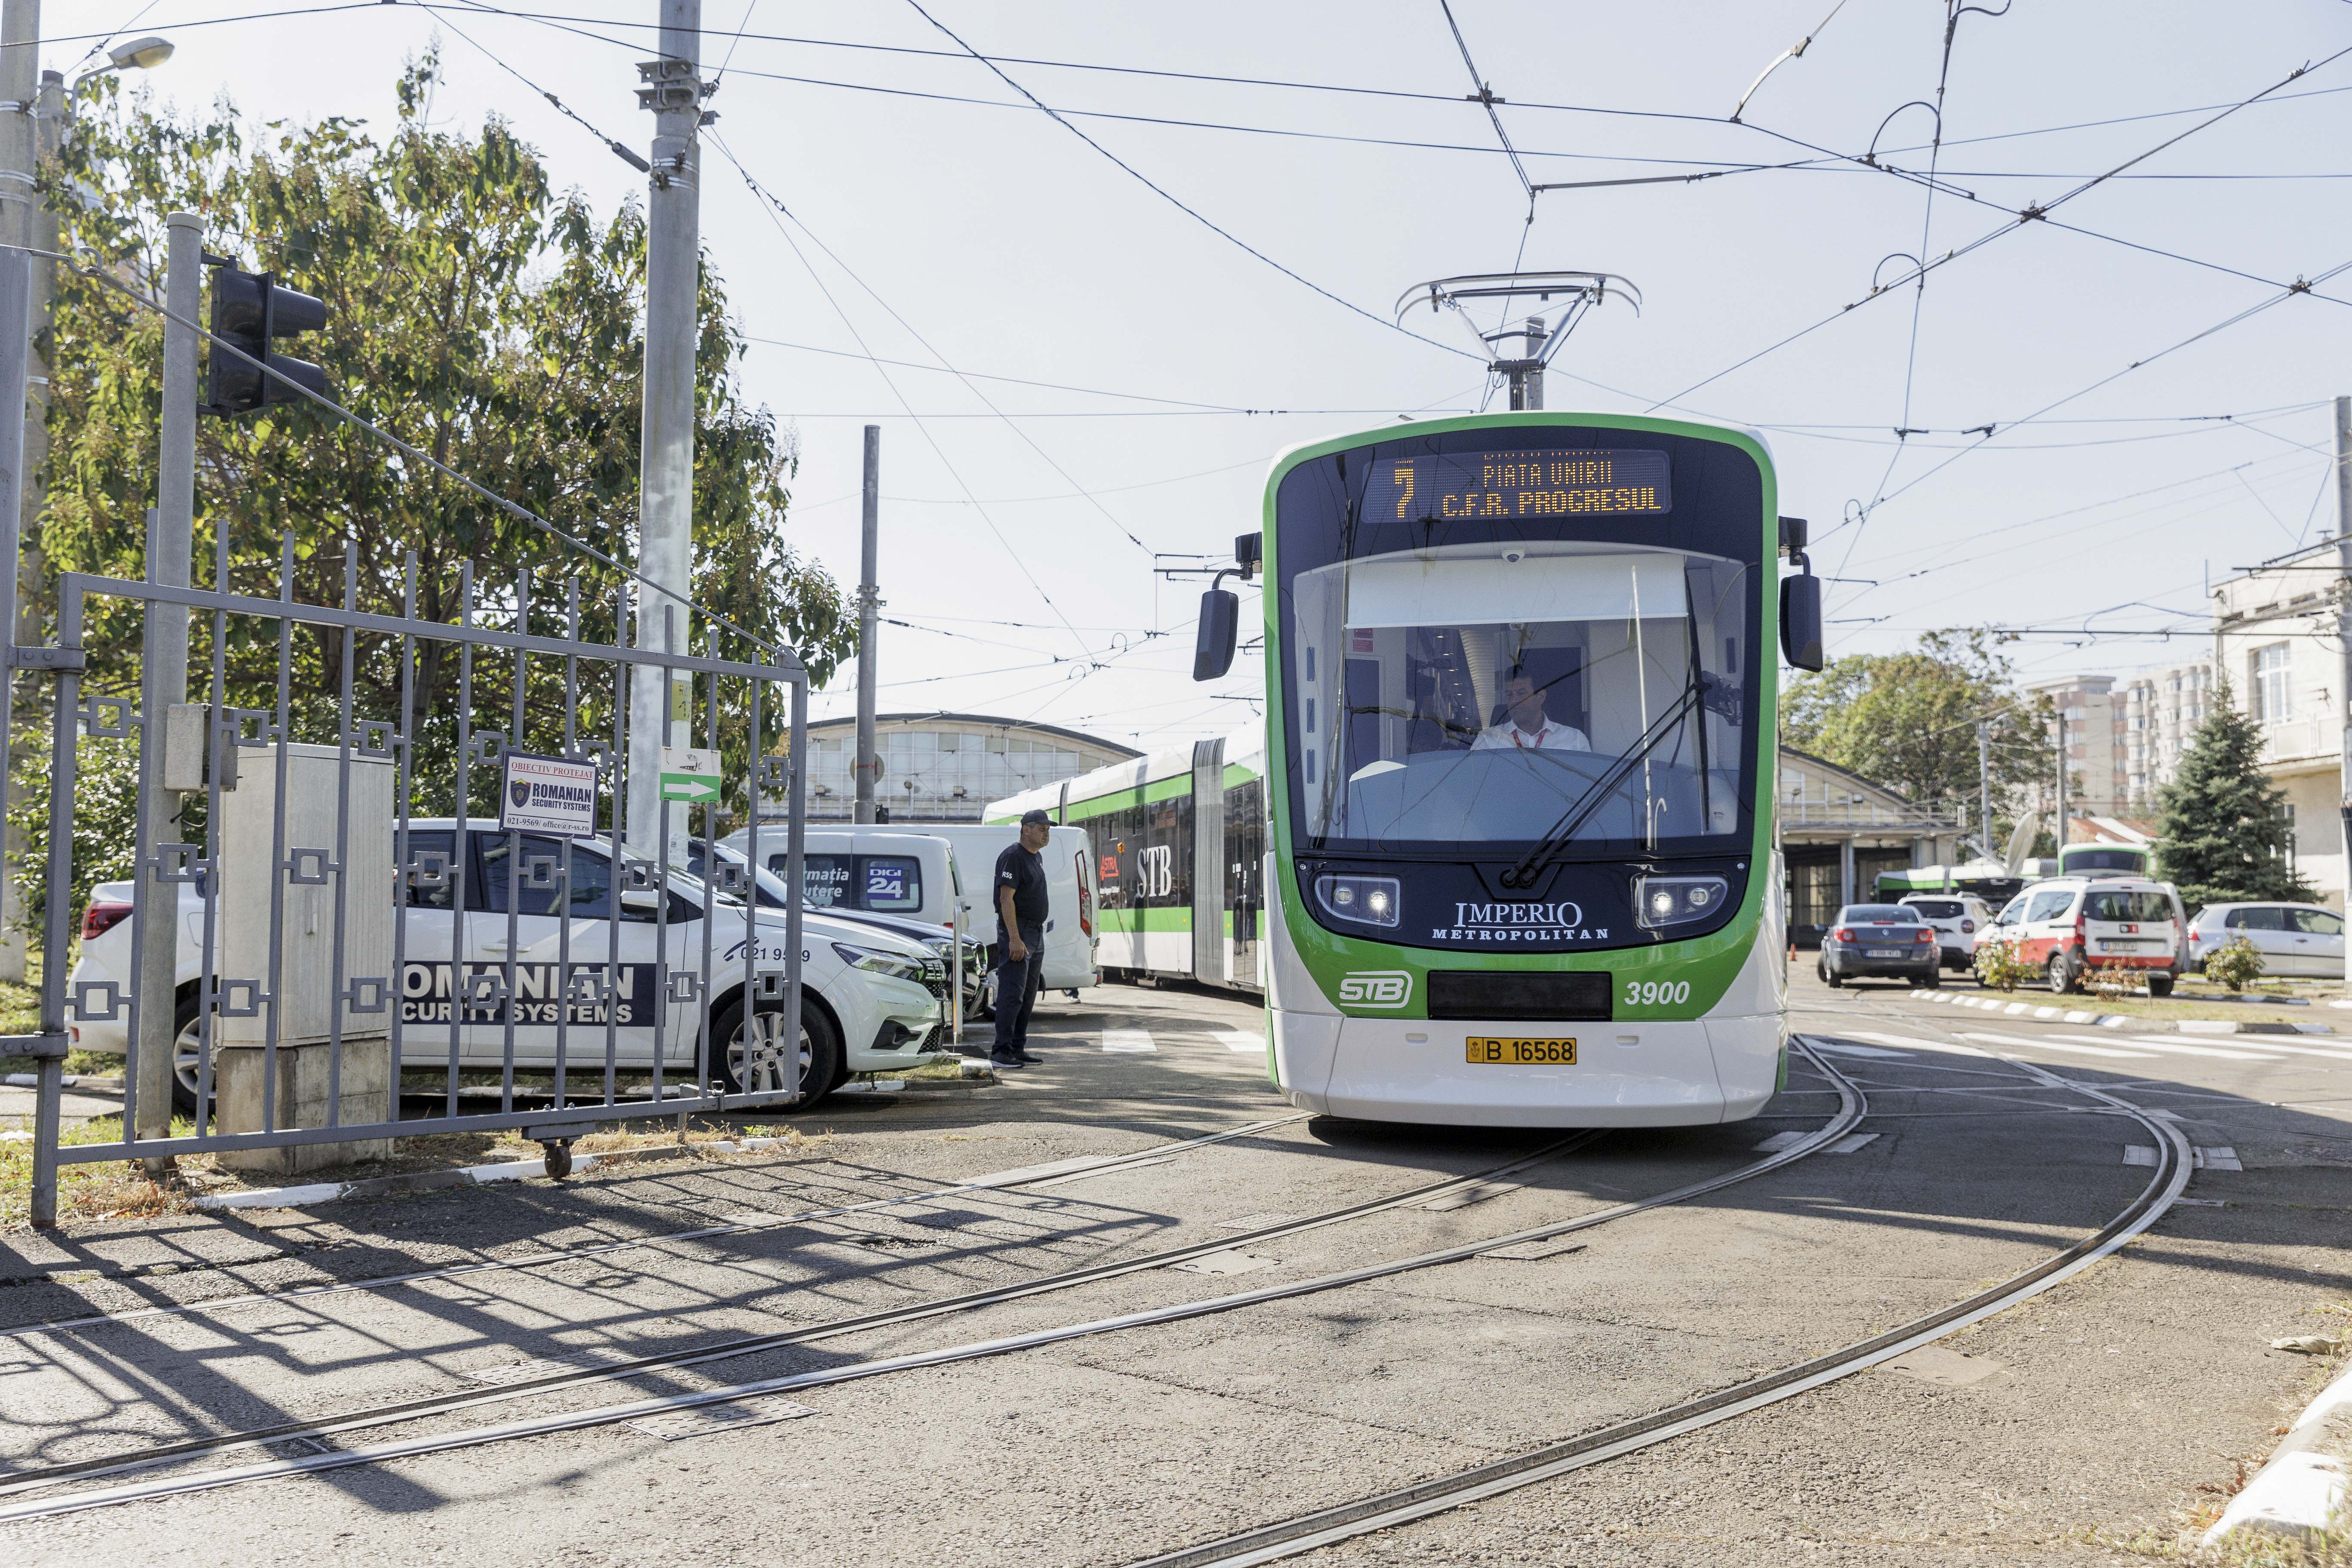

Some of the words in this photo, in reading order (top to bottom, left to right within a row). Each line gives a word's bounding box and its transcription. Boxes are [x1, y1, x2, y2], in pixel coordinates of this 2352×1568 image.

[1484, 463, 1541, 488] PIATA
[1551, 461, 1611, 484] UNIRII
[1395, 469, 1414, 518] 7
[1443, 493, 1508, 516] C.F.R.
[1519, 487, 1661, 514] PROGRESUL
[511, 762, 552, 773] OBIECTIV
[554, 767, 593, 778] PROTEJAT
[533, 783, 591, 802] ROMANIAN
[532, 798, 562, 809] SECURITY
[563, 802, 591, 812] SYSTEMS
[543, 821, 589, 831] office@r-ss.ro
[1002, 871, 1013, 879] RSS
[1100, 854, 1119, 881] ASTRA
[1137, 845, 1172, 898] STB
[803, 885, 842, 897] utere
[867, 877, 903, 898] 24
[1454, 902, 1583, 928] IMPERIO
[1433, 928, 1608, 941] METROPOLITAN
[773, 948, 810, 962] 99
[402, 964, 634, 999] OMANIAN
[1339, 978, 1405, 1001] STB
[1624, 981, 1690, 1005] 3900
[1487, 1040, 1502, 1060] B
[1513, 1041, 1574, 1061] 16568
